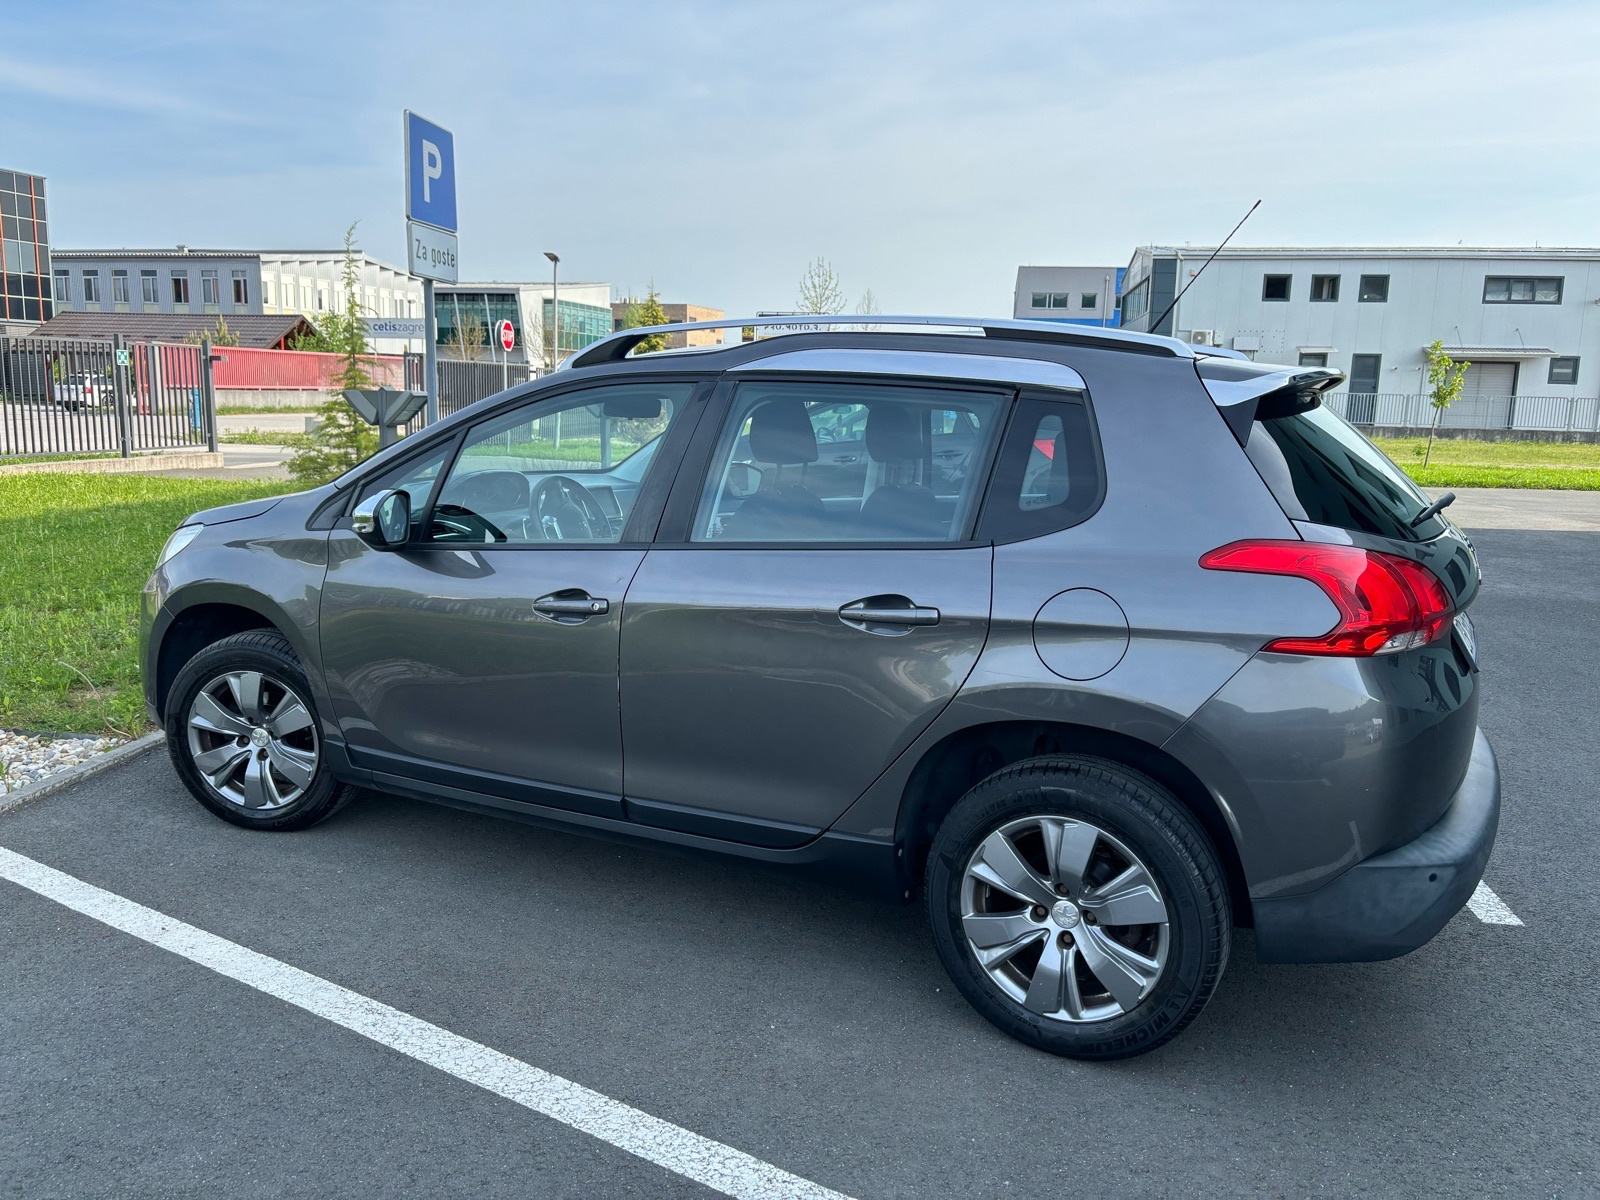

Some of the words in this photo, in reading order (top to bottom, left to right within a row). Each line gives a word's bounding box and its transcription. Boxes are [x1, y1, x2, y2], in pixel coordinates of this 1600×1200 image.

[422, 139, 442, 204] P
[415, 238, 427, 260] Za
[431, 248, 455, 268] goste
[373, 320, 425, 335] cetiszagre
